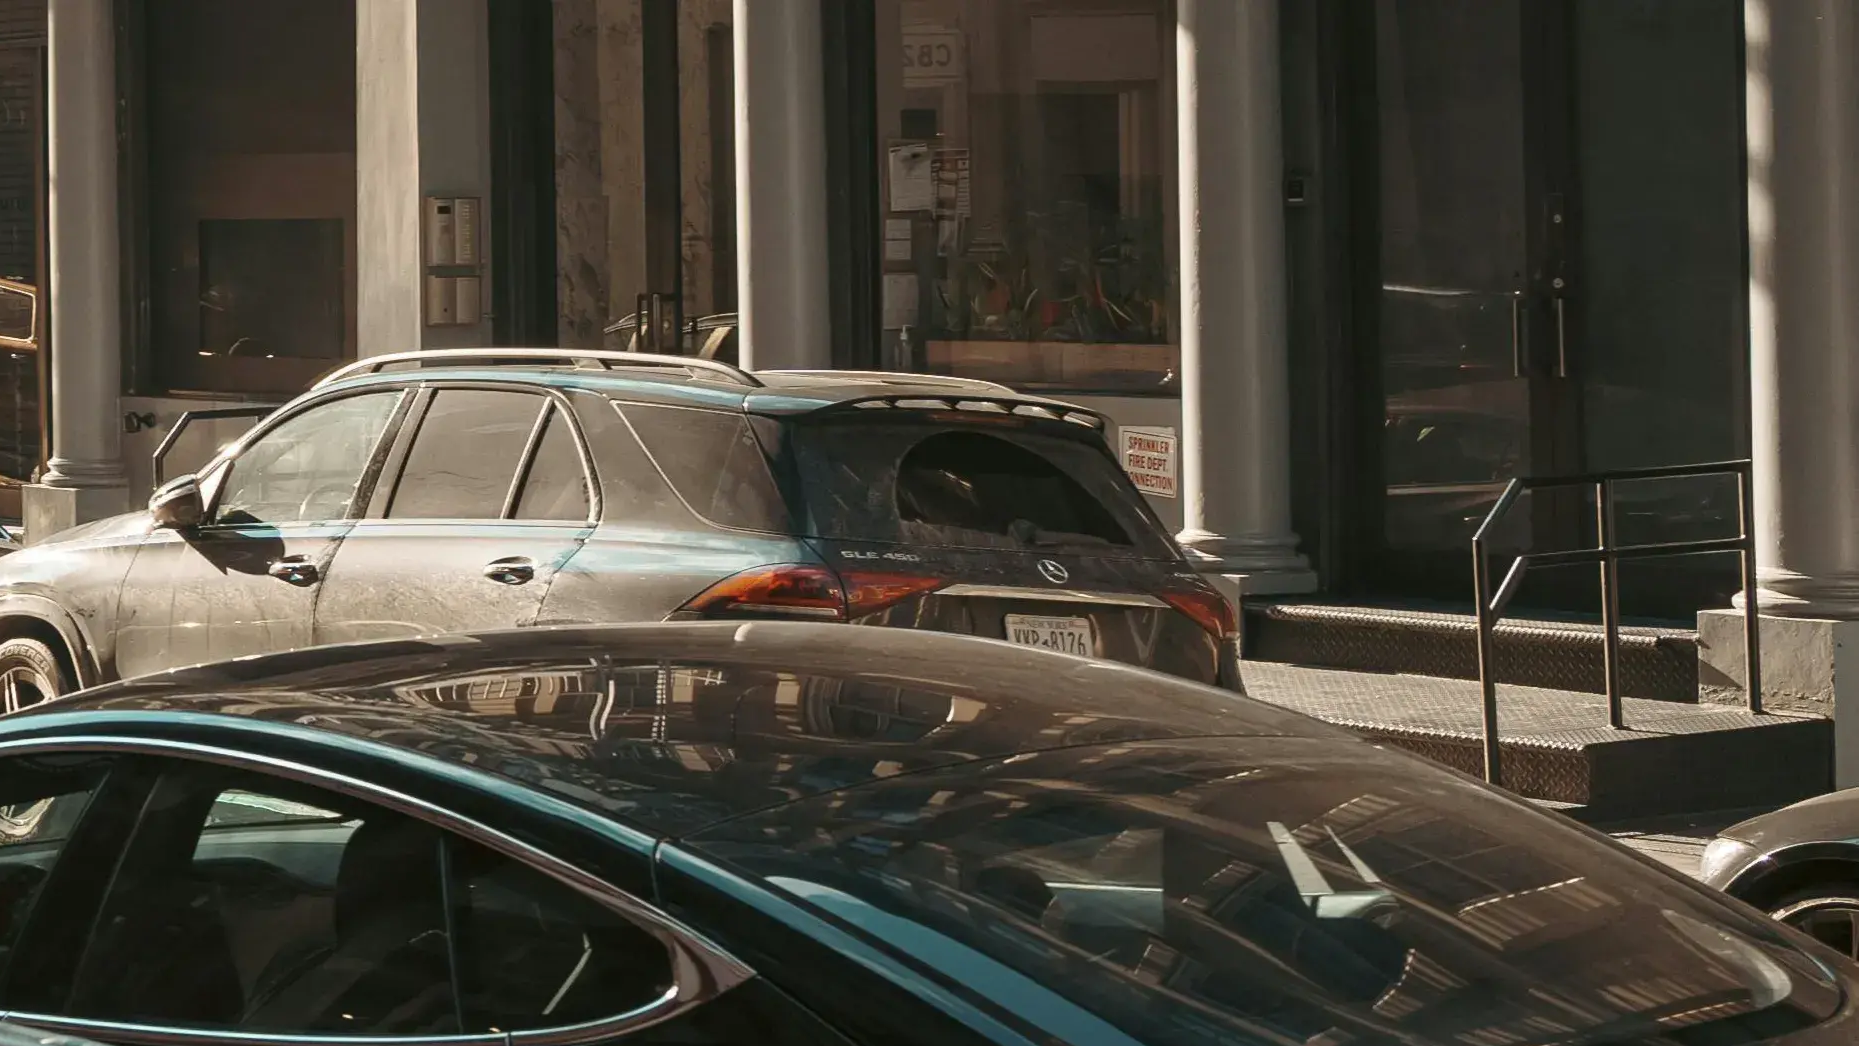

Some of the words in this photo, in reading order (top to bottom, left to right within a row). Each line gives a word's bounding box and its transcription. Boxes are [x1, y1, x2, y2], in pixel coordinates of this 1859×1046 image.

[1128, 436, 1170, 453] SPRINKLER
[1129, 454, 1146, 469] FIRE
[841, 550, 880, 559] GLE
[882, 552, 920, 562] 450
